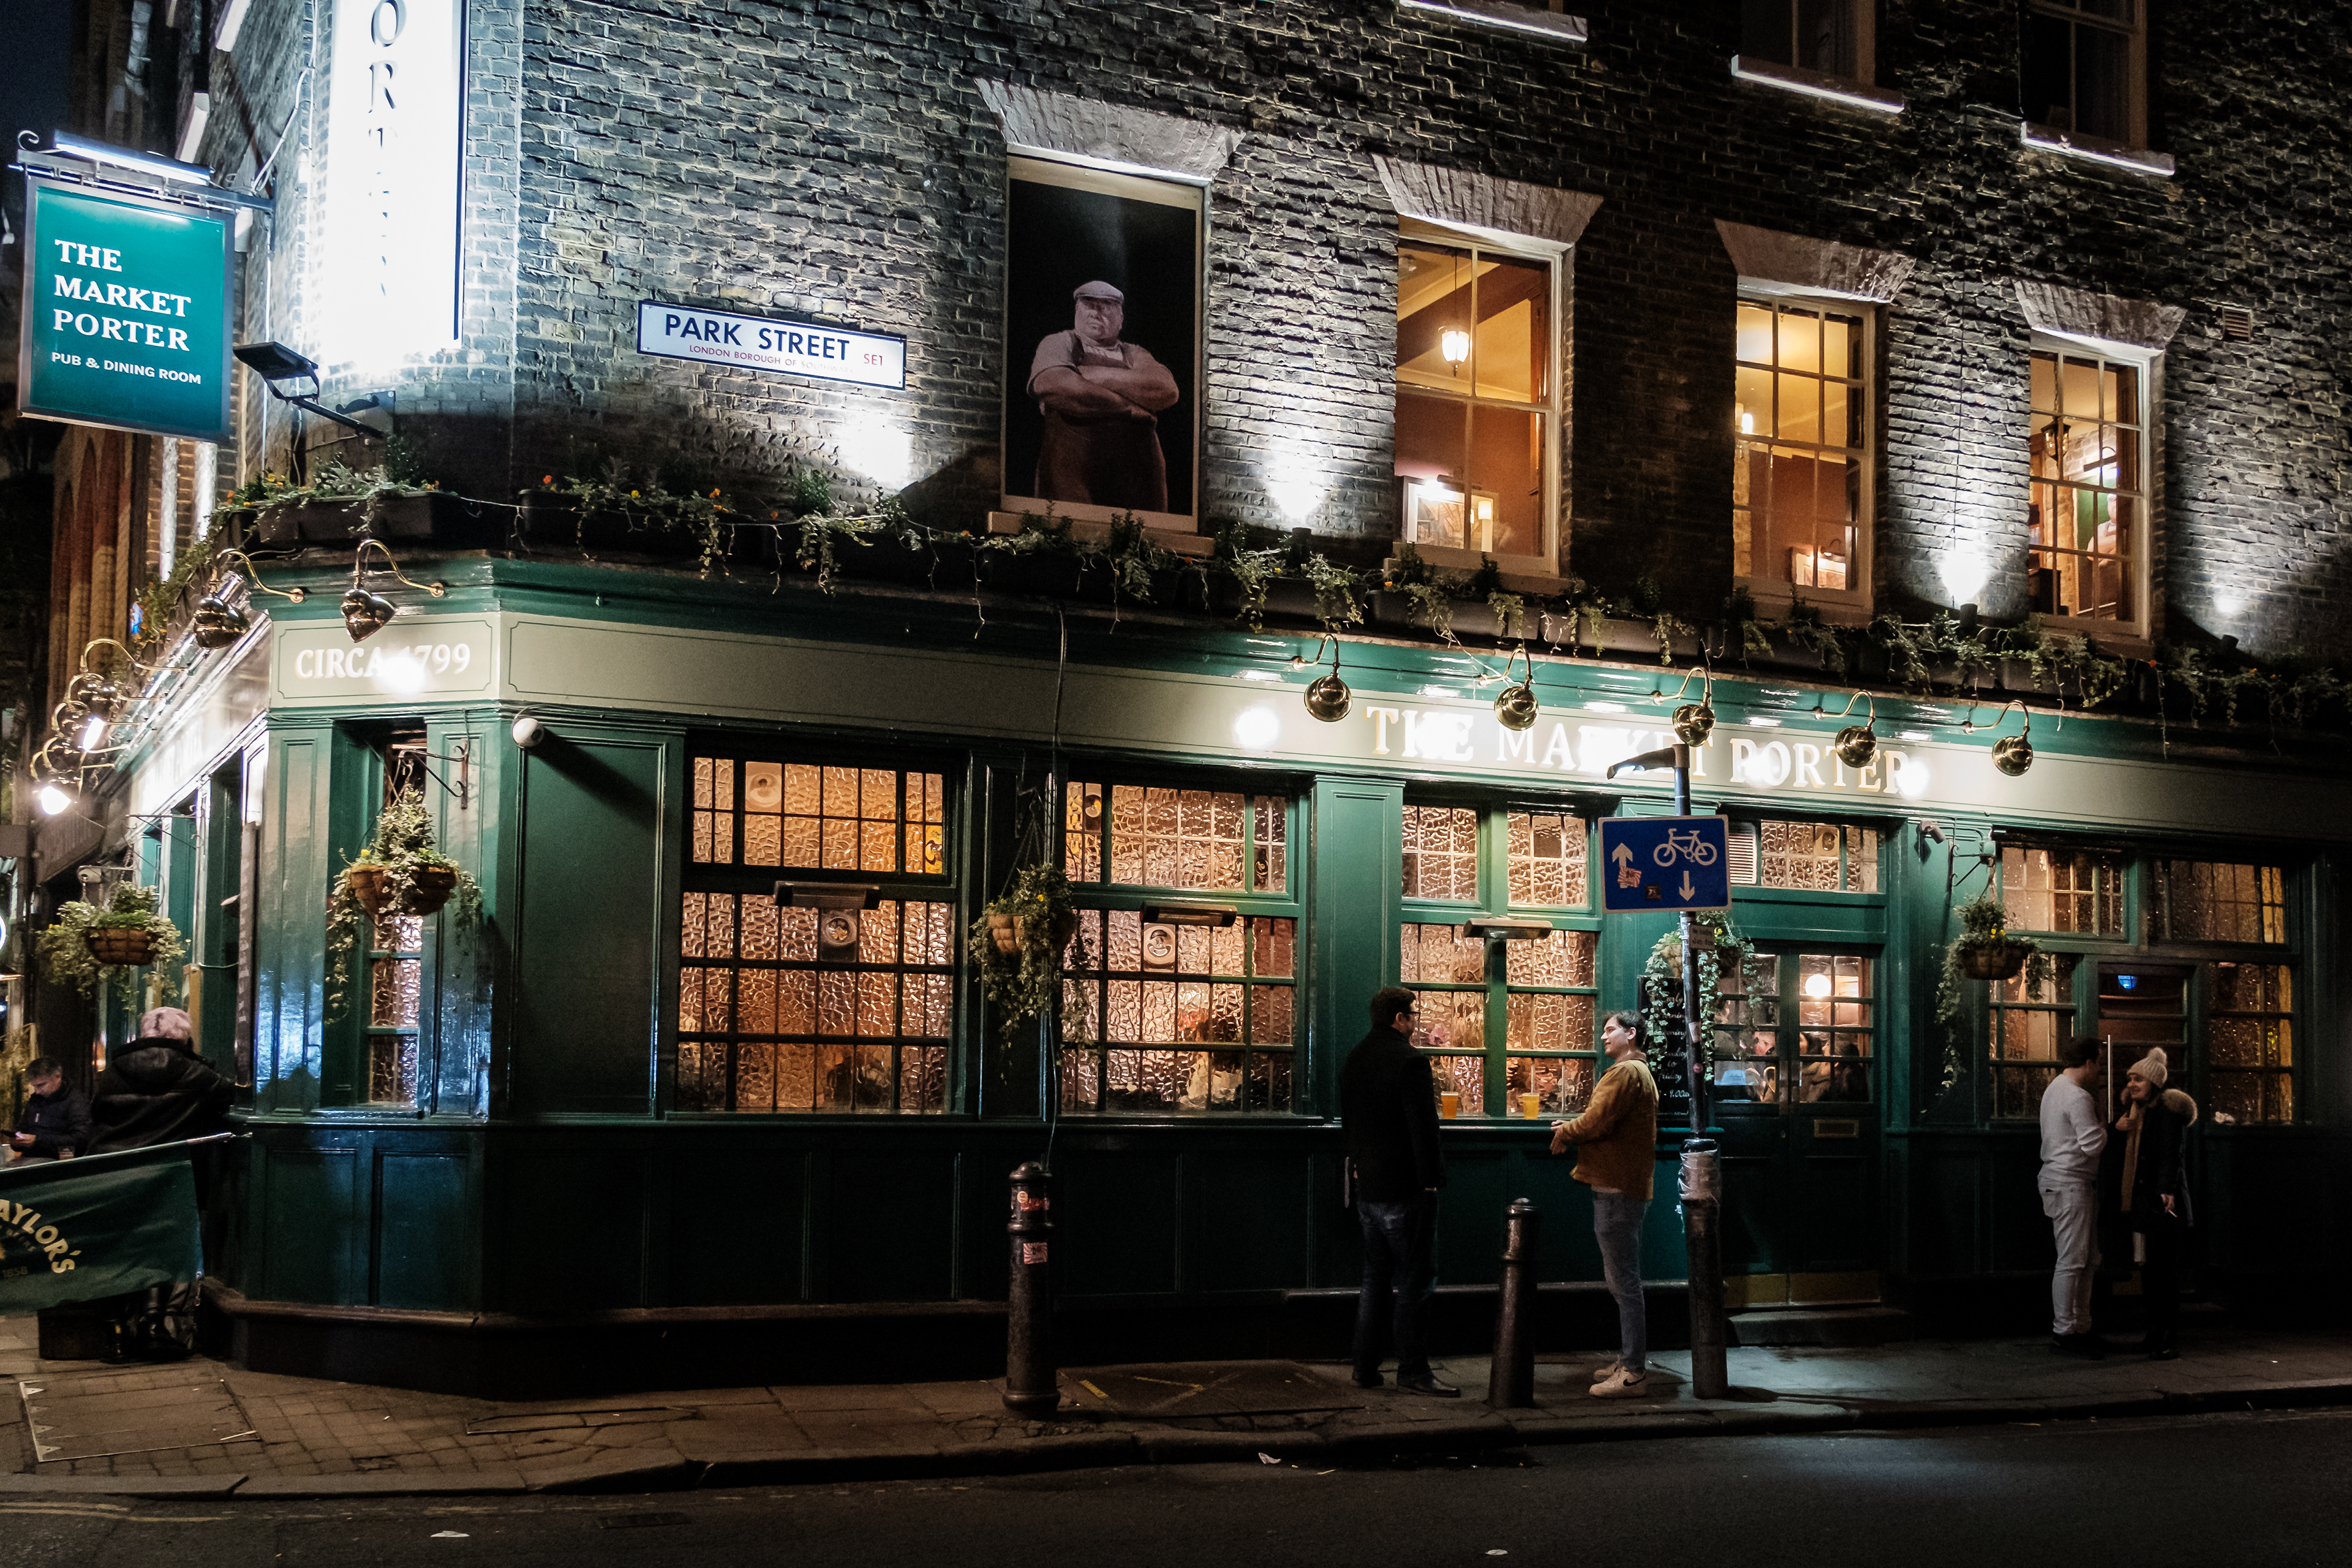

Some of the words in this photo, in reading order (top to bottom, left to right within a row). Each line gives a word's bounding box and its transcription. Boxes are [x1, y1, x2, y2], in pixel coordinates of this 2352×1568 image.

[54, 239, 123, 272] THE
[53, 274, 192, 317] MARKET
[53, 308, 190, 352] PORTER
[665, 314, 742, 346] PARK
[758, 328, 850, 360] STREET
[51, 351, 81, 366] PUB
[86, 357, 100, 369] &
[104, 360, 156, 377] DINING
[159, 368, 201, 385] ROOM
[689, 344, 731, 358] LONDON
[734, 352, 781, 365] BOROUGH
[785, 359, 797, 368] OF
[863, 353, 883, 366] SE1
[295, 647, 385, 679] CIRCA
[398, 643, 471, 676] 799
